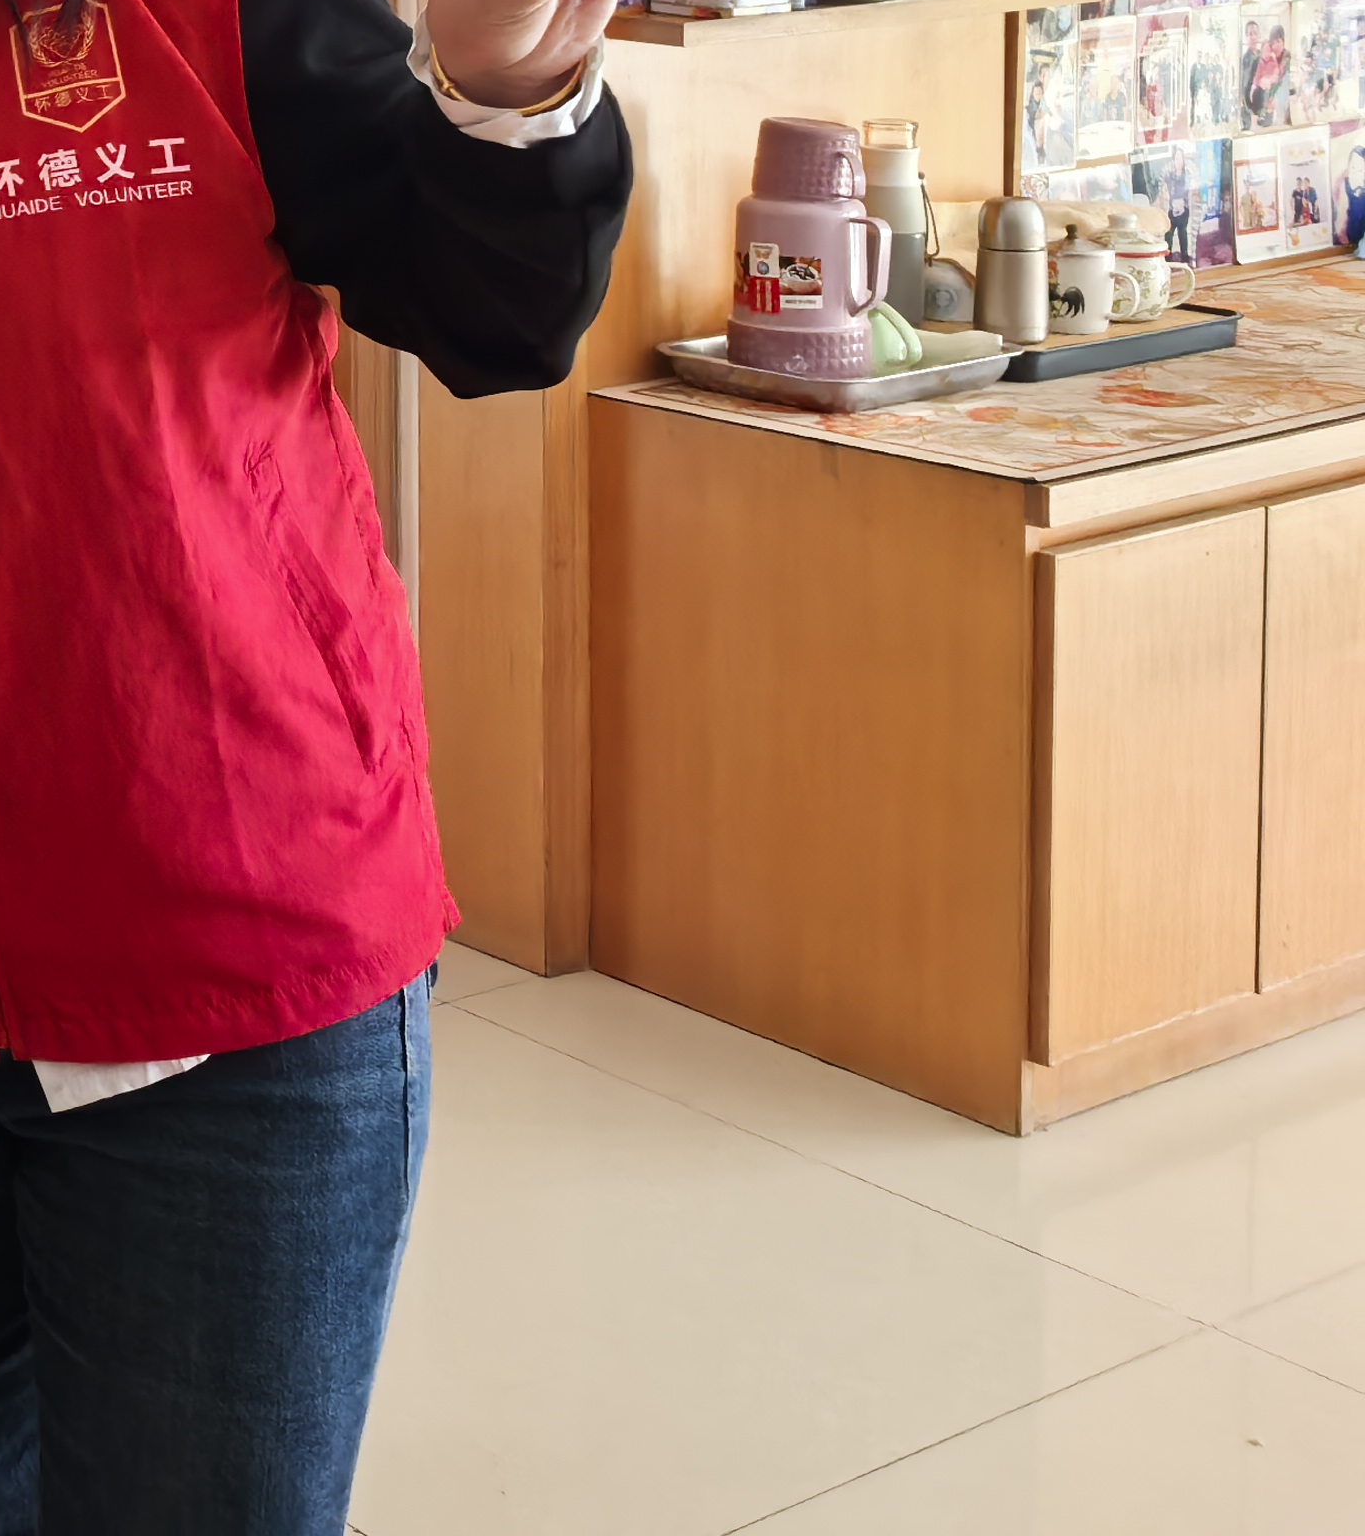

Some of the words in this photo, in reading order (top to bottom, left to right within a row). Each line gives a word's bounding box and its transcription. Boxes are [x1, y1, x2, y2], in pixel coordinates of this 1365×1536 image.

[34, 84, 114, 114] 怀德义工
[74, 179, 194, 207] VOLUNTEER
